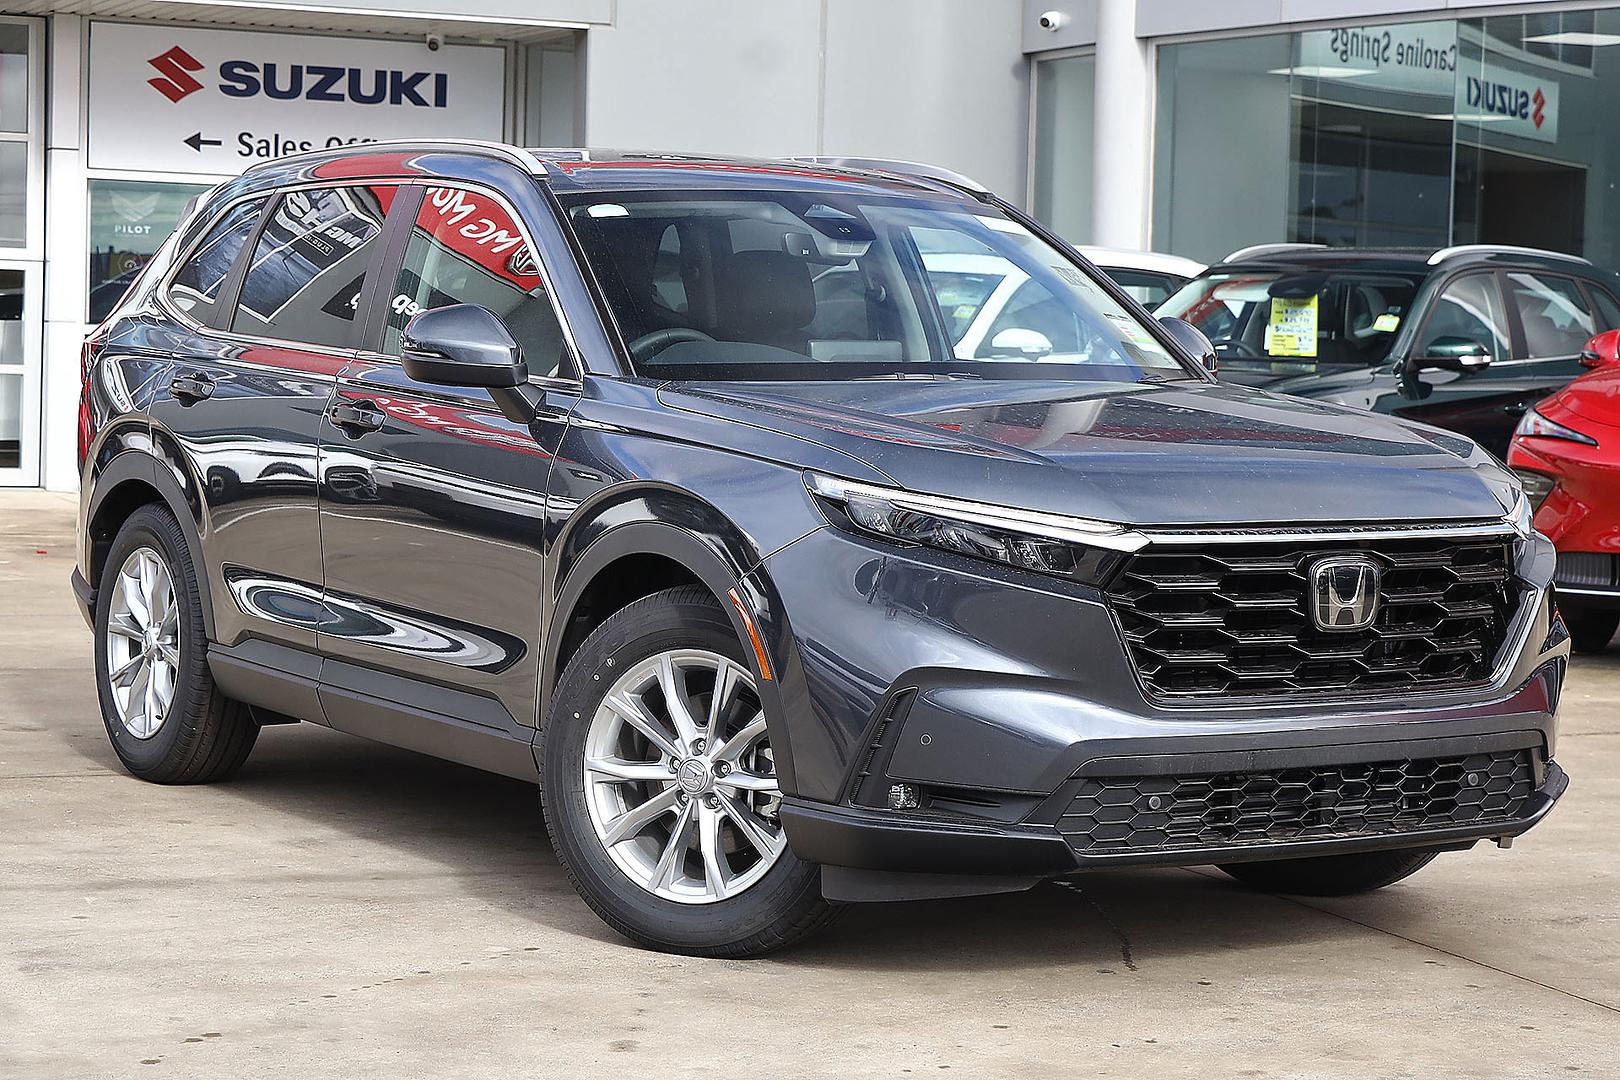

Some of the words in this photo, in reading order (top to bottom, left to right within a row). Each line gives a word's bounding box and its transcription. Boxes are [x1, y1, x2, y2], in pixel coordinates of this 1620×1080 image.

[219, 60, 448, 108] SUZUKI
[237, 131, 313, 158] Sales
[114, 225, 152, 235] PILOT
